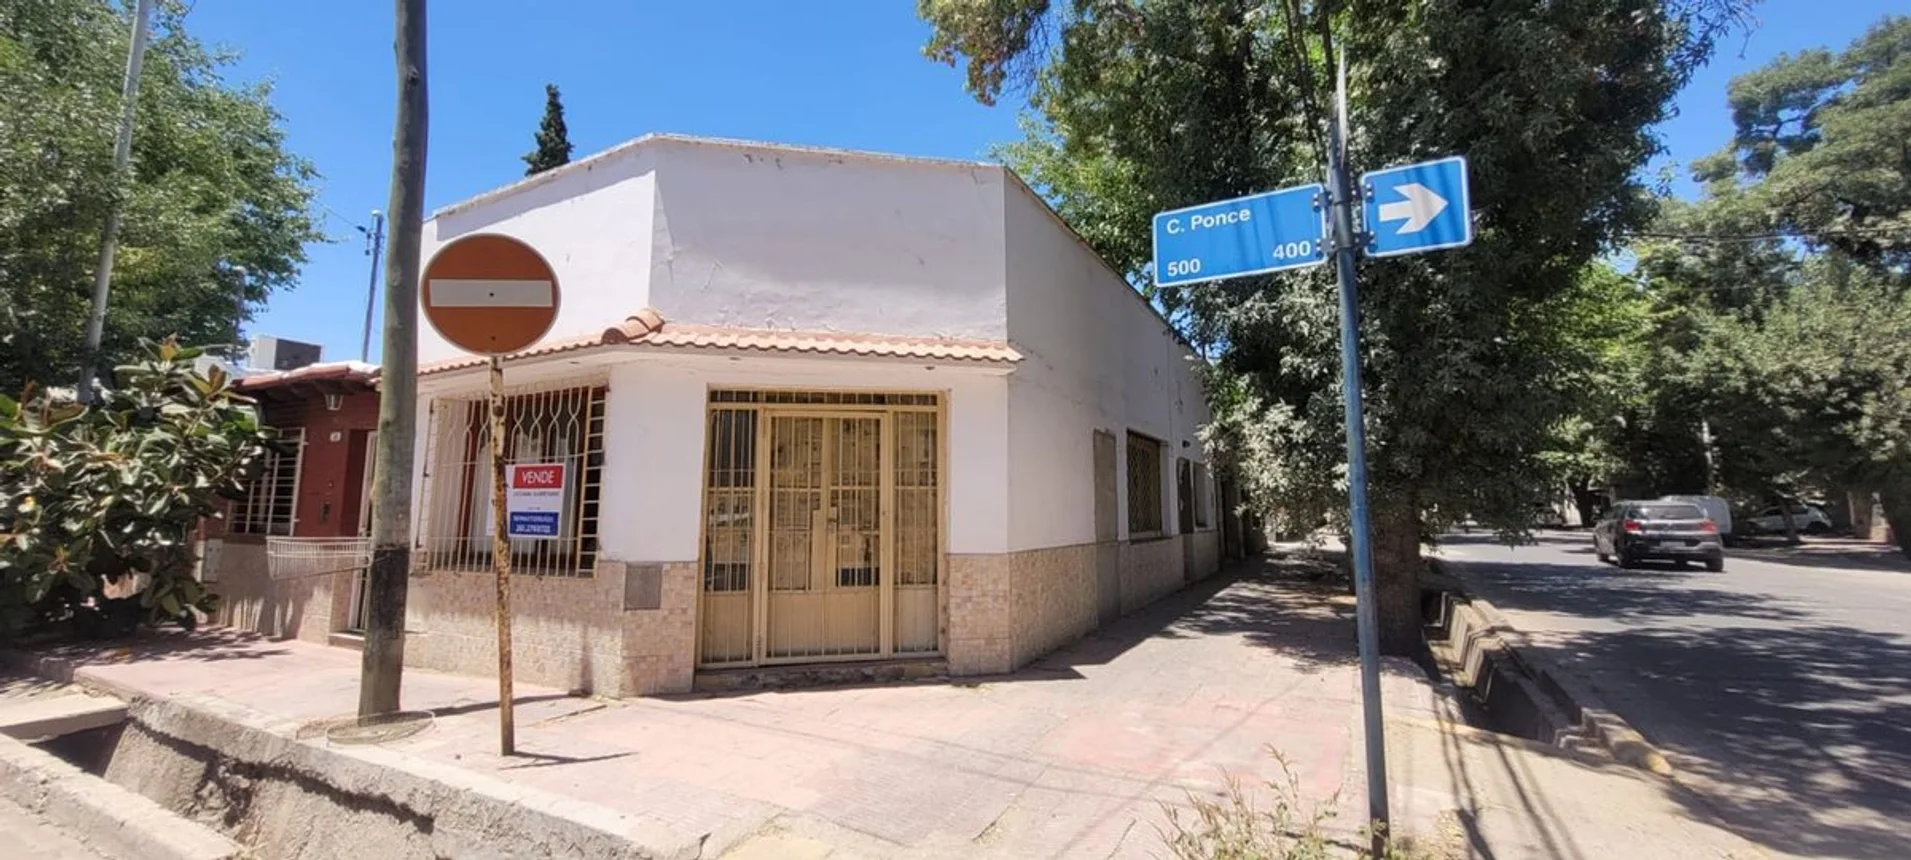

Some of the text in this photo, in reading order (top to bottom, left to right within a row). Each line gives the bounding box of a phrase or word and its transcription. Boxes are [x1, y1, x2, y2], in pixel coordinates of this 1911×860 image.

[1166, 208, 1251, 235] C. Ponce
[1167, 240, 1312, 277] 500 400
[521, 470, 556, 485] VENDE
